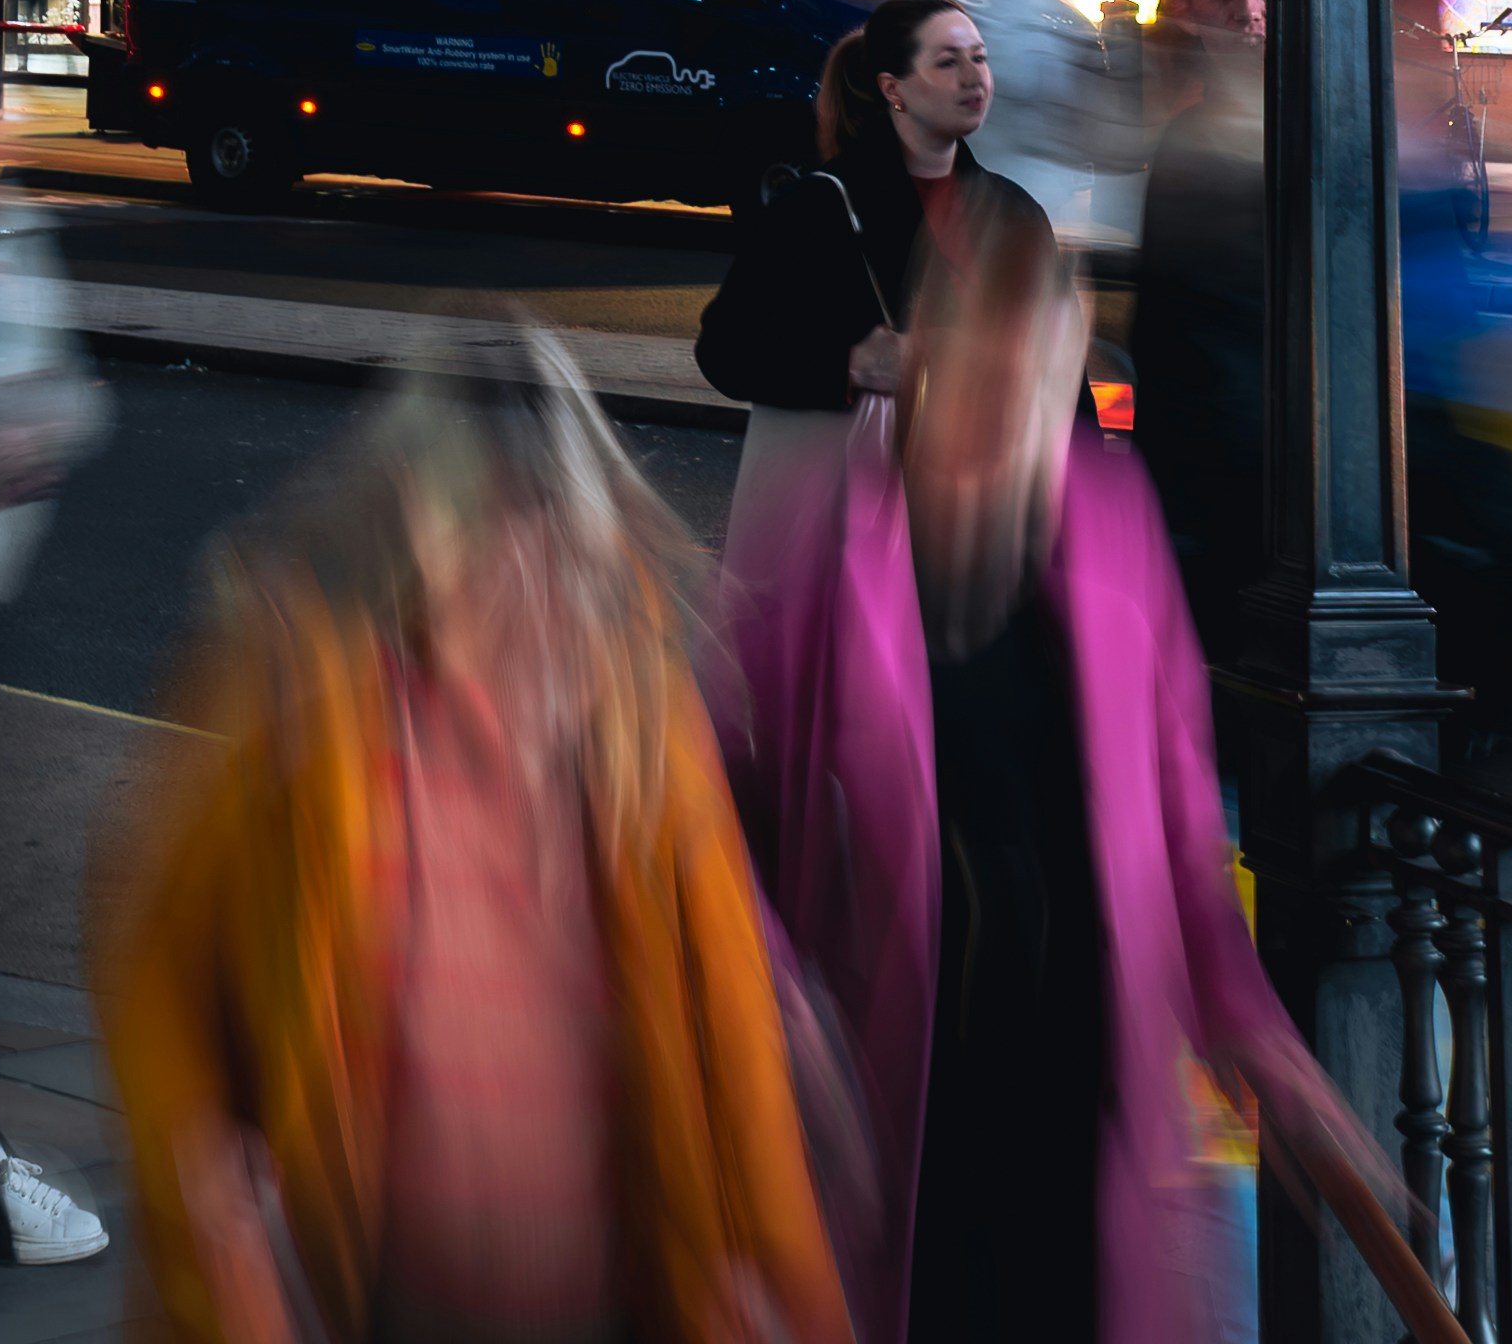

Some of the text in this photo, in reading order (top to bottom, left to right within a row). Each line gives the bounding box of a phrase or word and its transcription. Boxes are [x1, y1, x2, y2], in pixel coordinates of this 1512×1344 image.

[435, 37, 474, 49] WARNING
[382, 43, 531, 63] SmartWater Anti-Robbery system in use
[417, 57, 495, 71] 100% conviction rate
[619, 81, 693, 95] ZERO EMISSIONS
